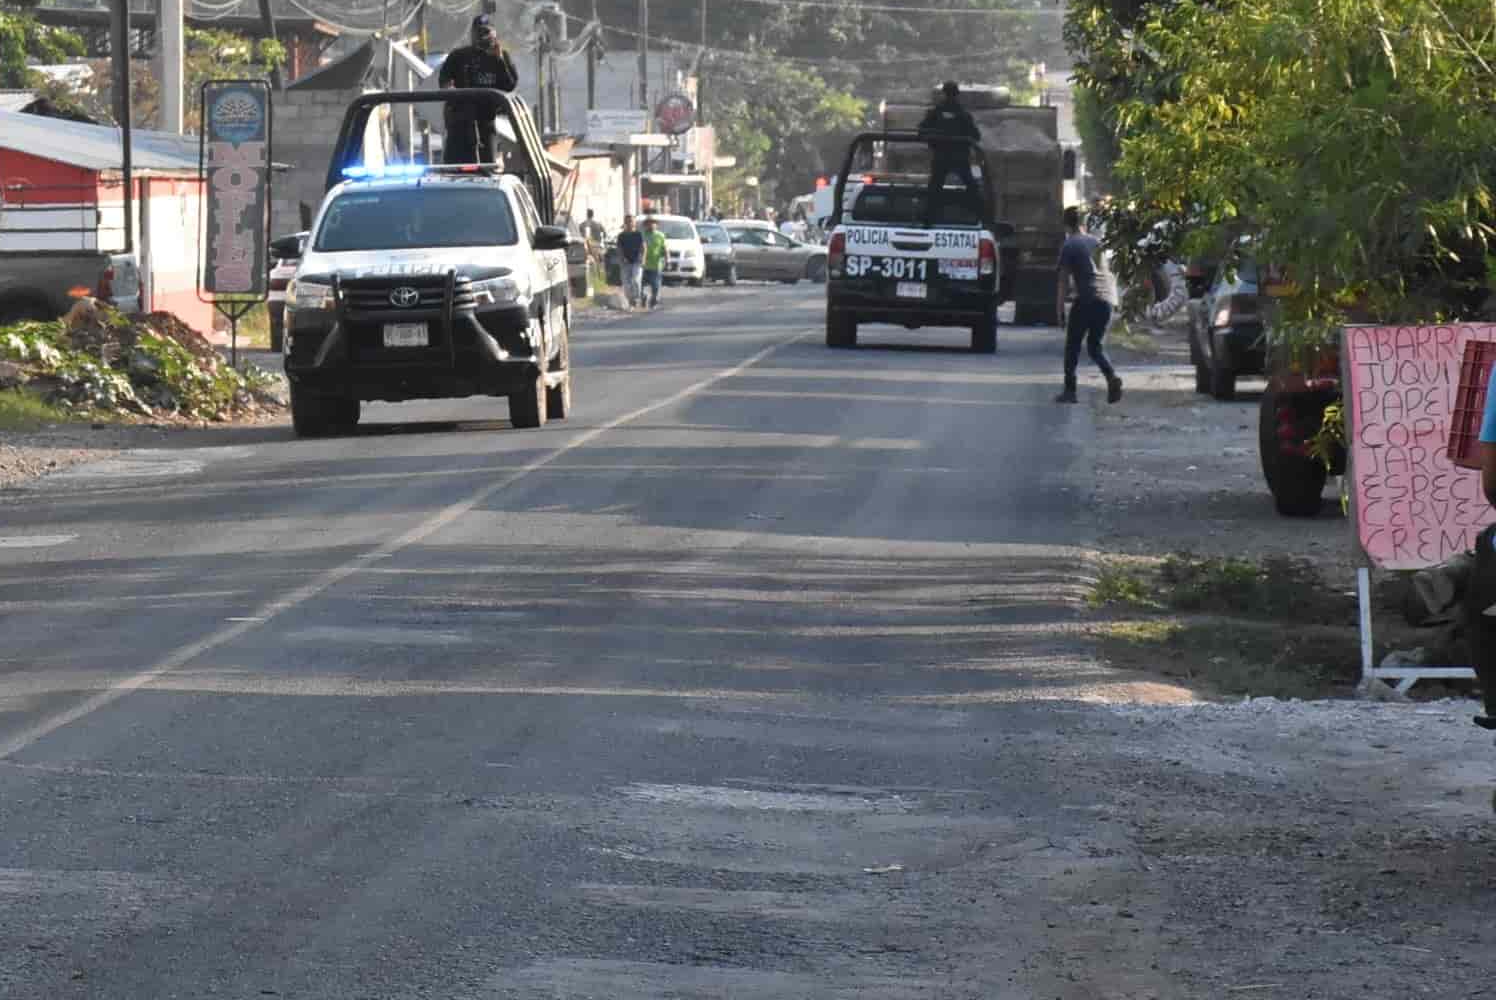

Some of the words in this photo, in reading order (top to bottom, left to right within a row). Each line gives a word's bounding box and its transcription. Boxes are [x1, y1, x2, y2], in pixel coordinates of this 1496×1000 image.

[847, 228, 890, 245] POLICIA
[934, 232, 978, 248] ESTATAL
[845, 255, 928, 281] SP-3011
